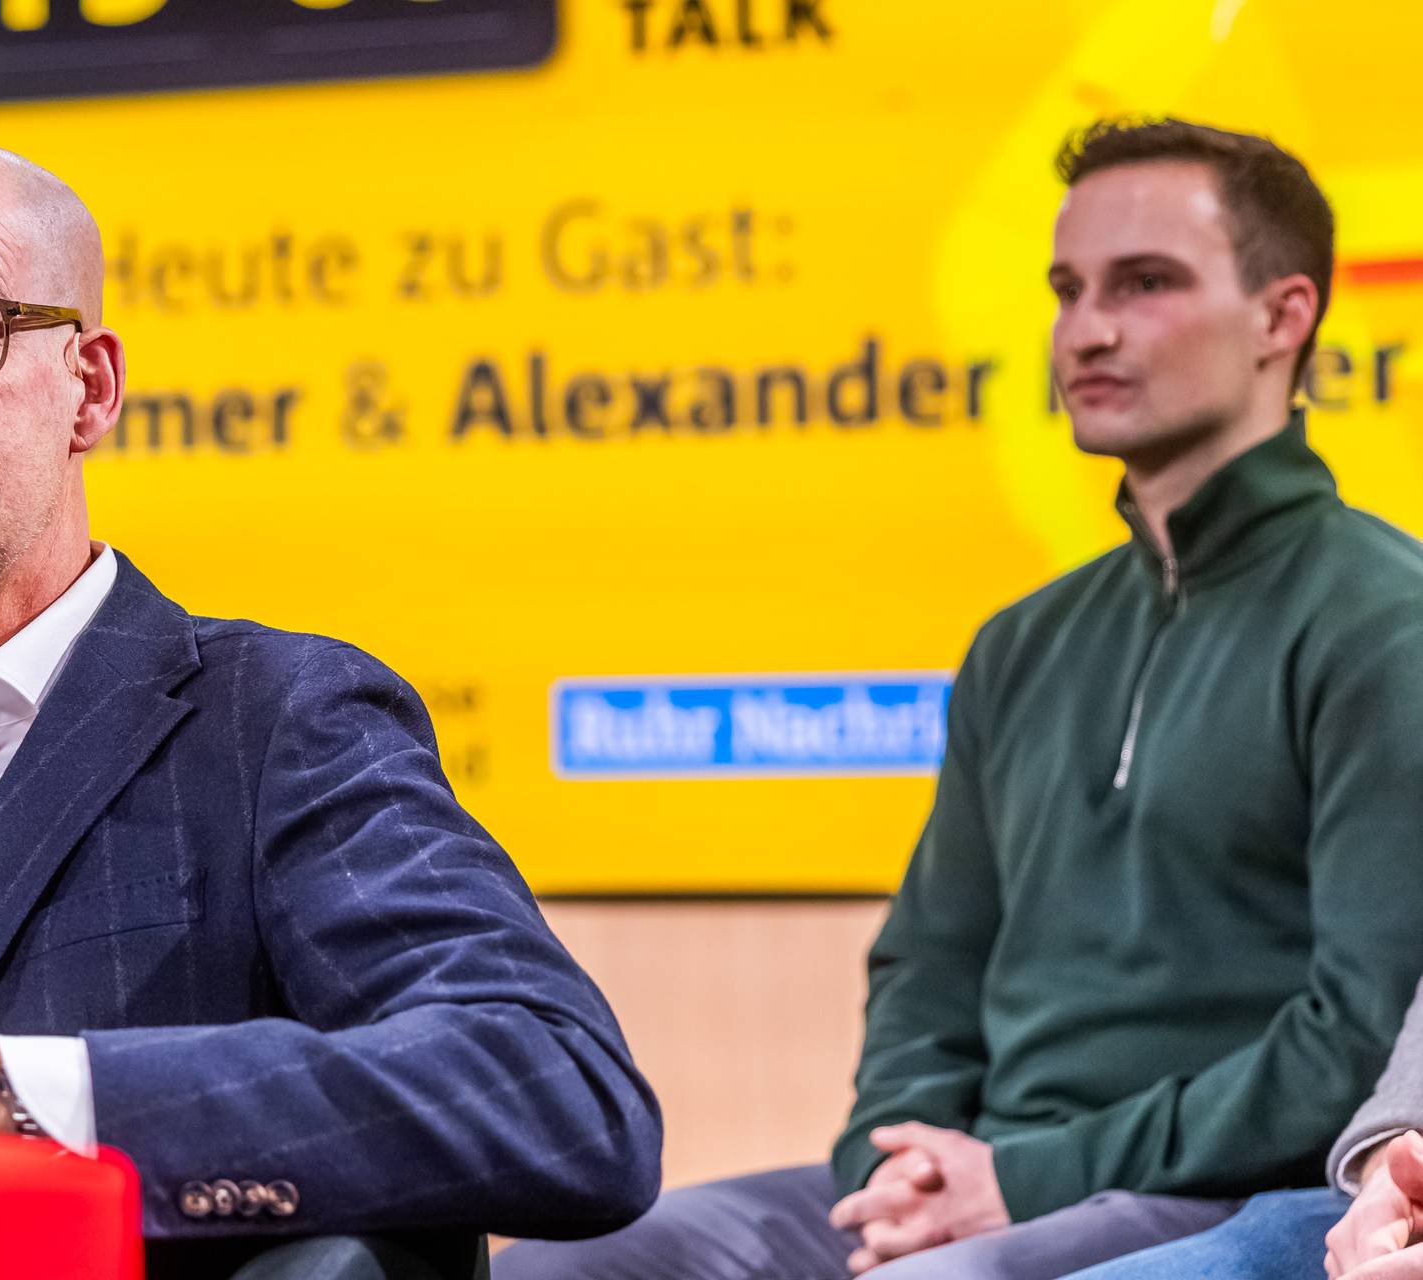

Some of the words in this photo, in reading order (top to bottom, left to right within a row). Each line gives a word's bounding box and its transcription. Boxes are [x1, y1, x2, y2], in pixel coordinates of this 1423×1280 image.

[621, 0, 833, 51] TALK
[396, 228, 503, 301] zu
[541, 198, 795, 296] Gast:
[105, 386, 301, 455] mer
[341, 359, 405, 450] &
[451, 338, 995, 442] Alexander
[730, 684, 945, 760] Nachri
